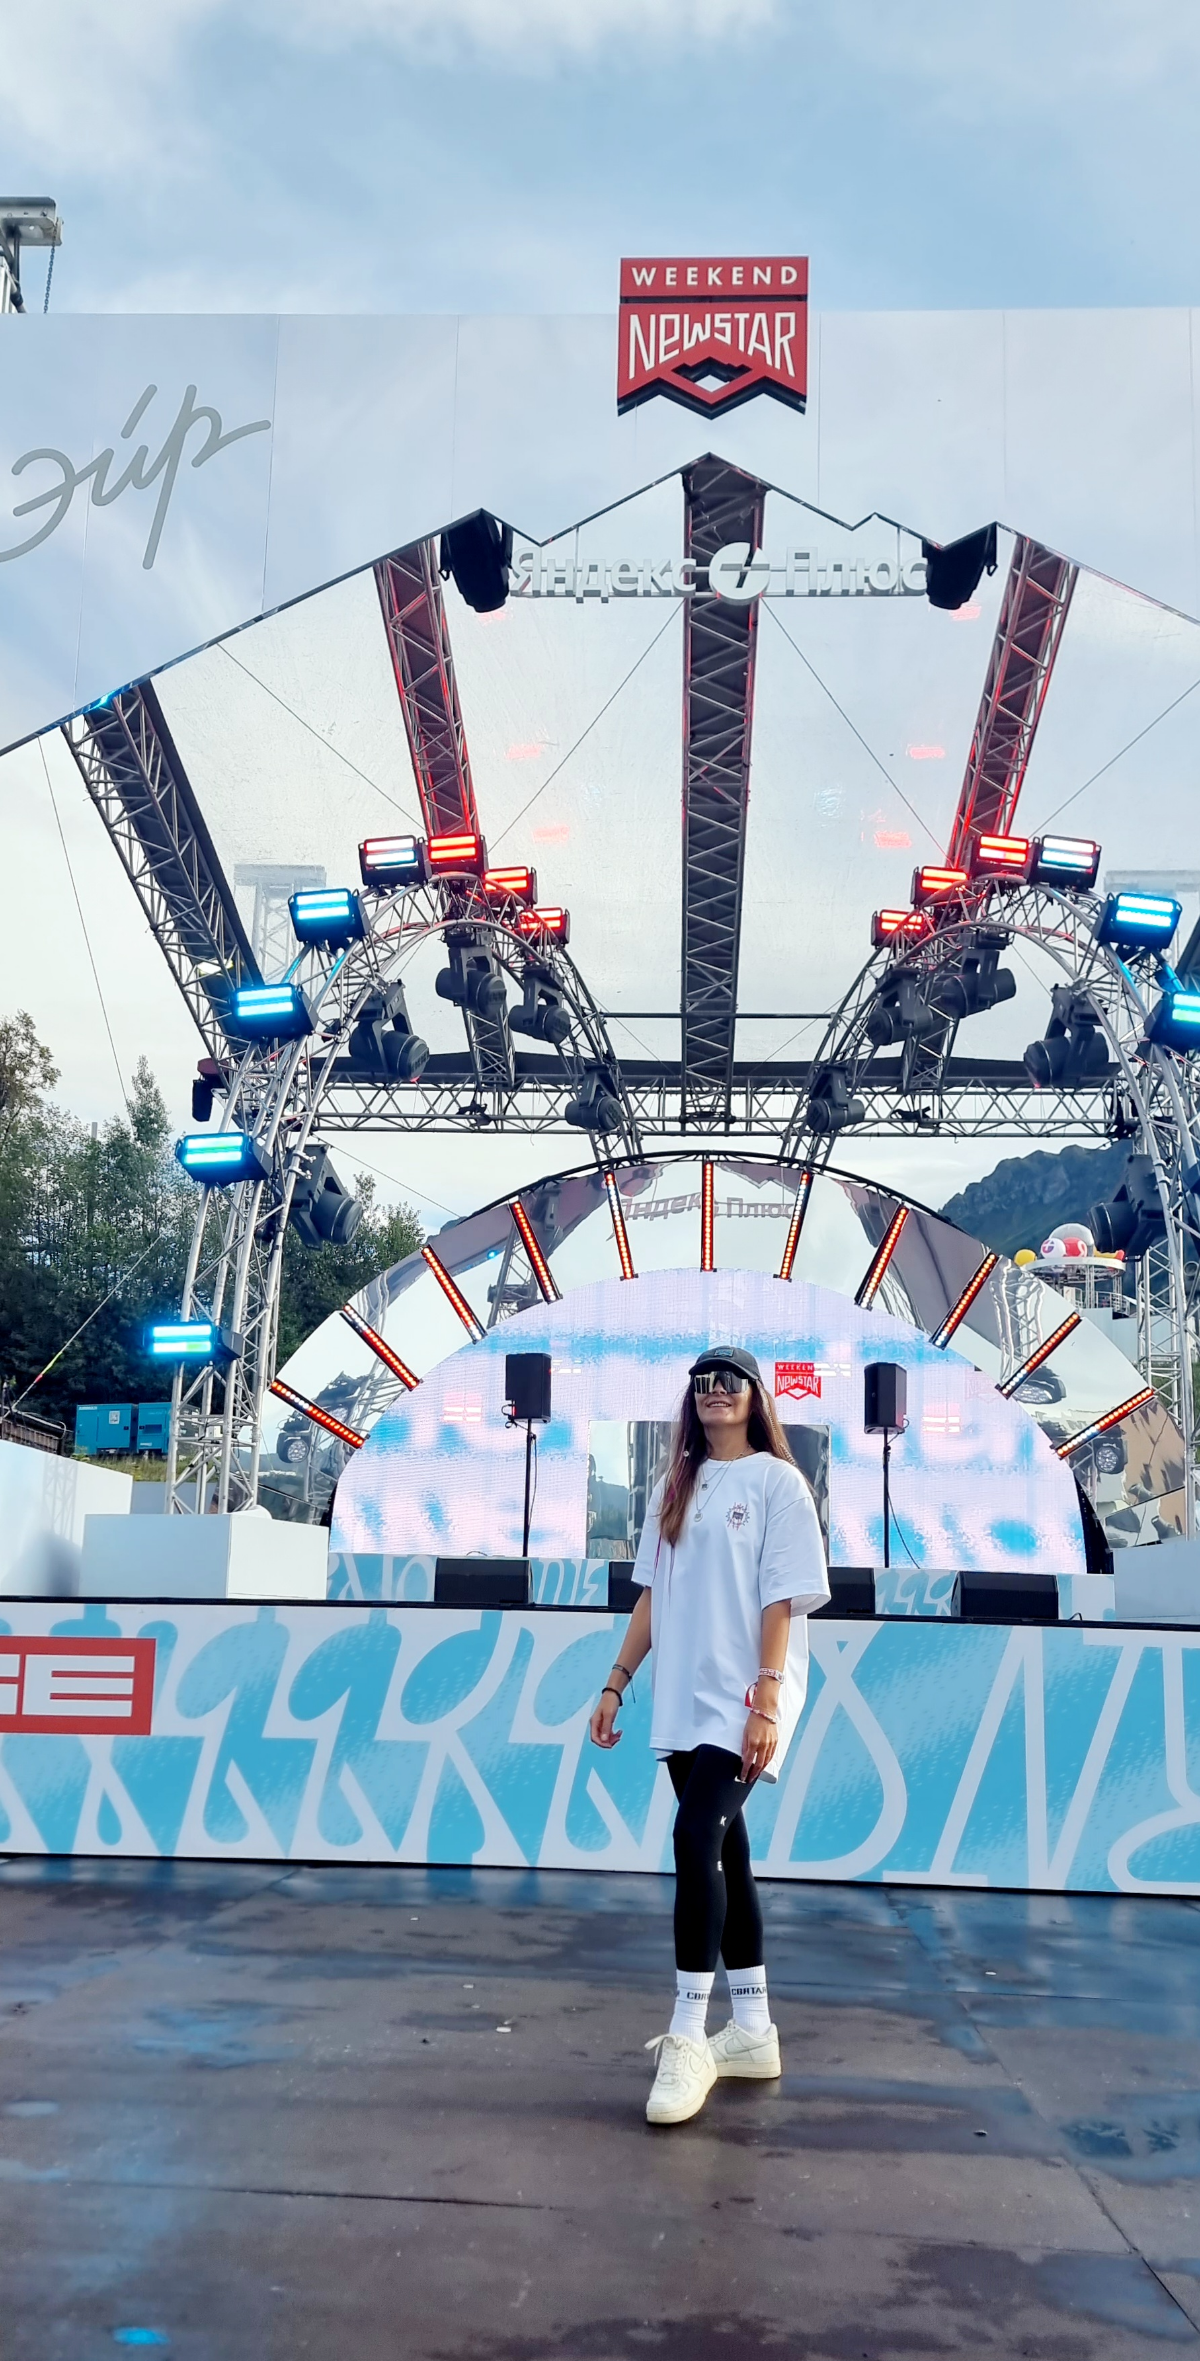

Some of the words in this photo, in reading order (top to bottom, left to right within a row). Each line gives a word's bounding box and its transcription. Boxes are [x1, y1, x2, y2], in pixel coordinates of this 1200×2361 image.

[631, 266, 798, 286] WEEKEND
[510, 546, 697, 603] Яндекс
[785, 546, 928, 597] Плюс
[777, 1363, 814, 1371] WEEKEN
